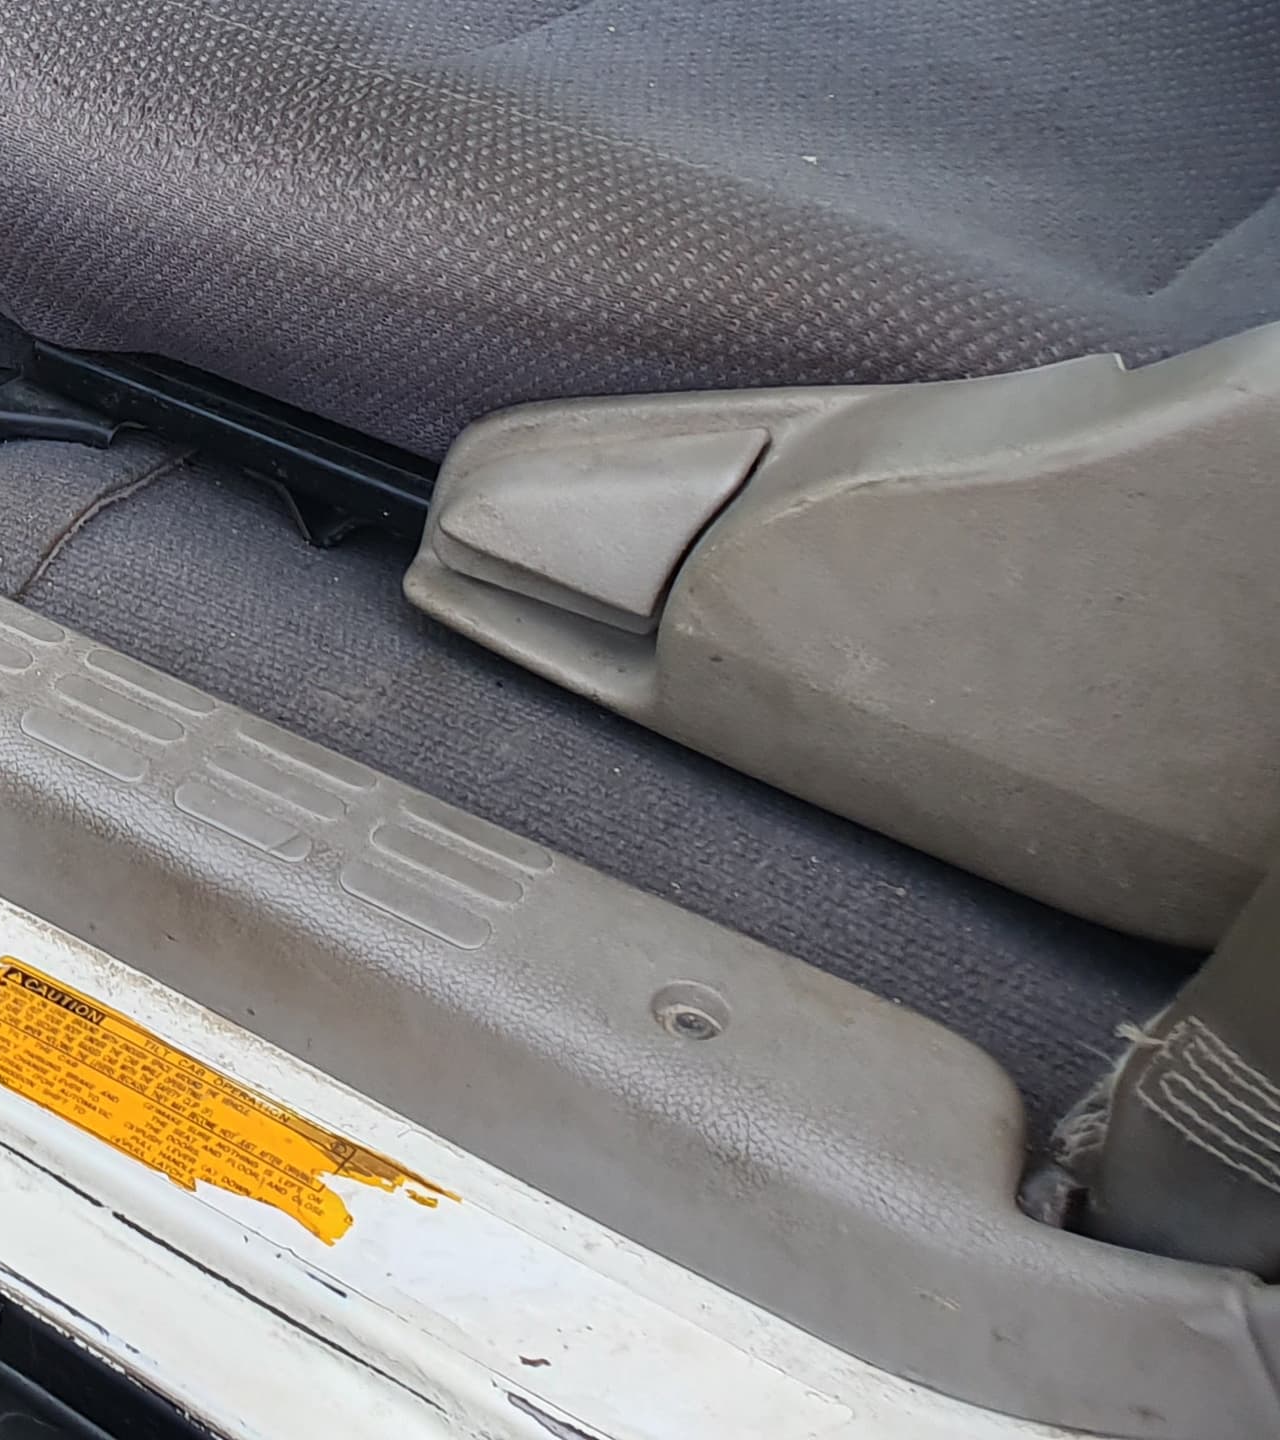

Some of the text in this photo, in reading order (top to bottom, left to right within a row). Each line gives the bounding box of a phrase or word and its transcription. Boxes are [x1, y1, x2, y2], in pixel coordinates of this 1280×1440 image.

[21, 976, 104, 1023] CAUTION
[175, 1057, 209, 1077] CAB
[210, 1076, 294, 1123] OPERATION
